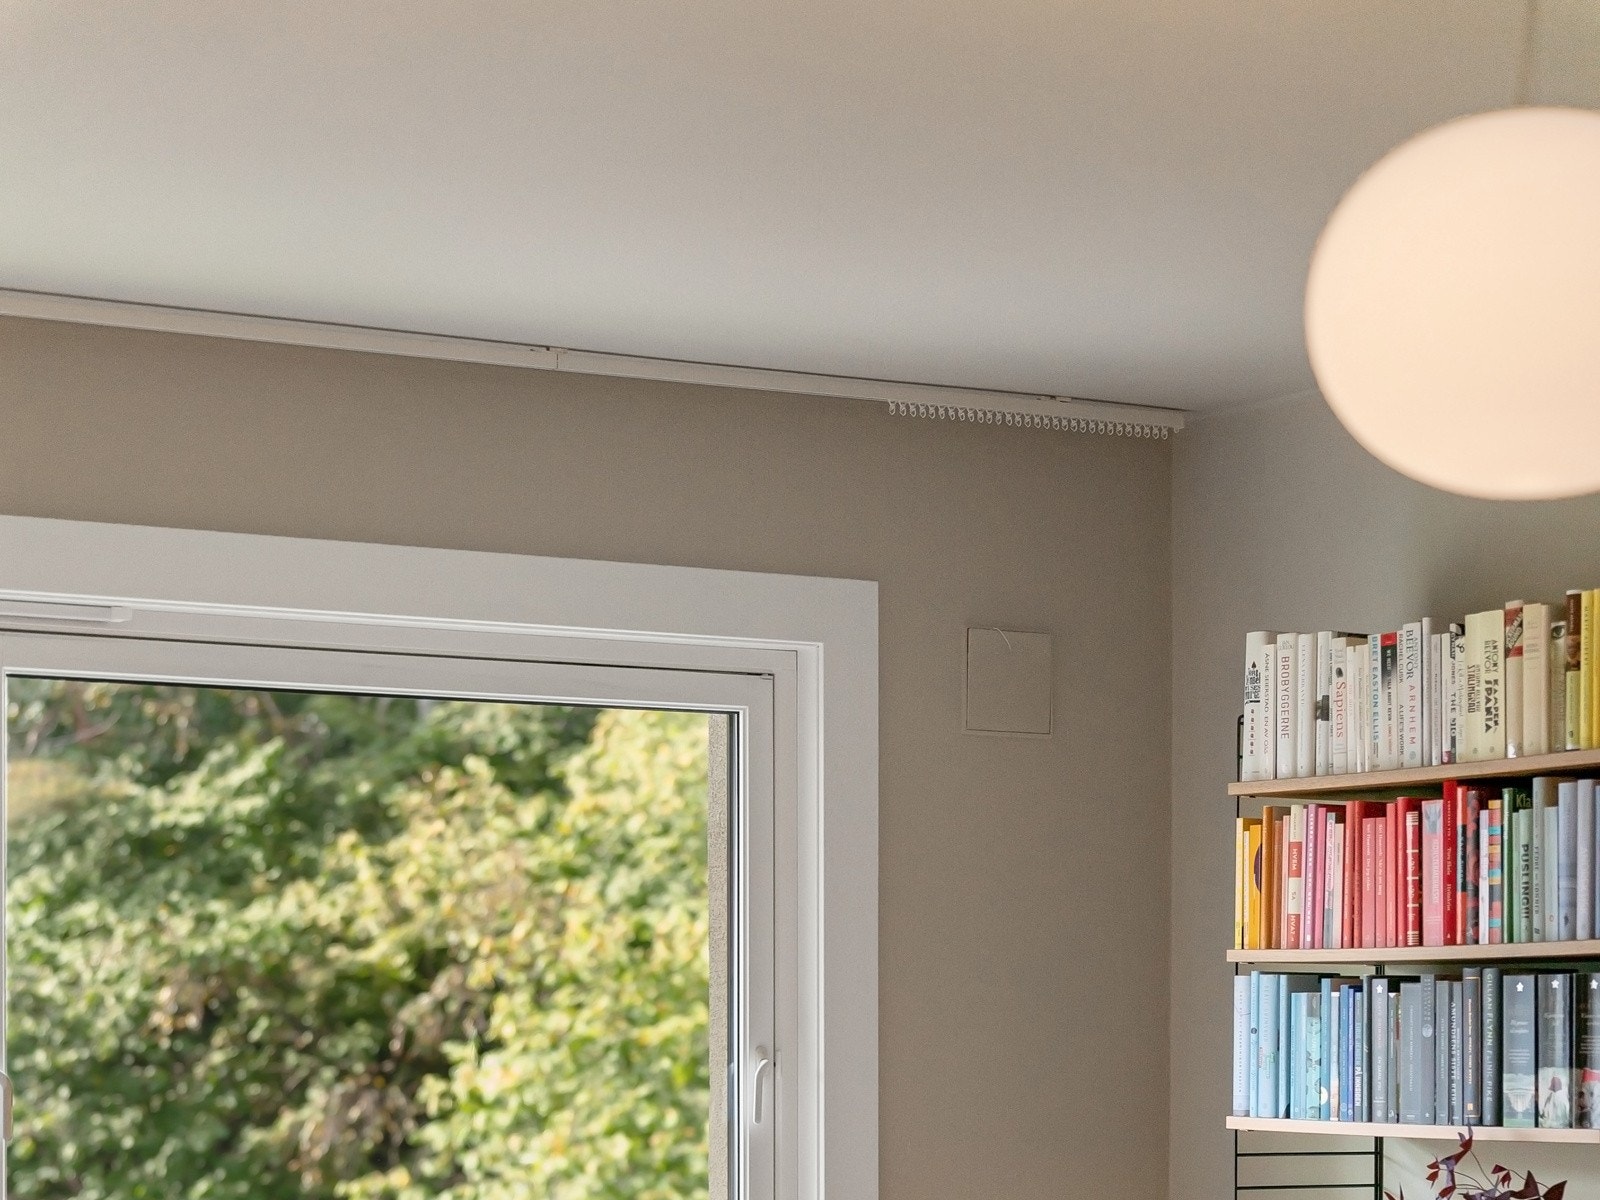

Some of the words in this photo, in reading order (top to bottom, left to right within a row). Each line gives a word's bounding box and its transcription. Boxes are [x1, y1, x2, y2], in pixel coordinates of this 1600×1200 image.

[1280, 656, 1290, 740] BROBYGGERNE
[1334, 681, 1346, 738] Sapiens
[1468, 664, 1476, 714] STALINGRAD
[1292, 892, 1296, 900] SA
[1355, 1066, 1364, 1076] PÅ
